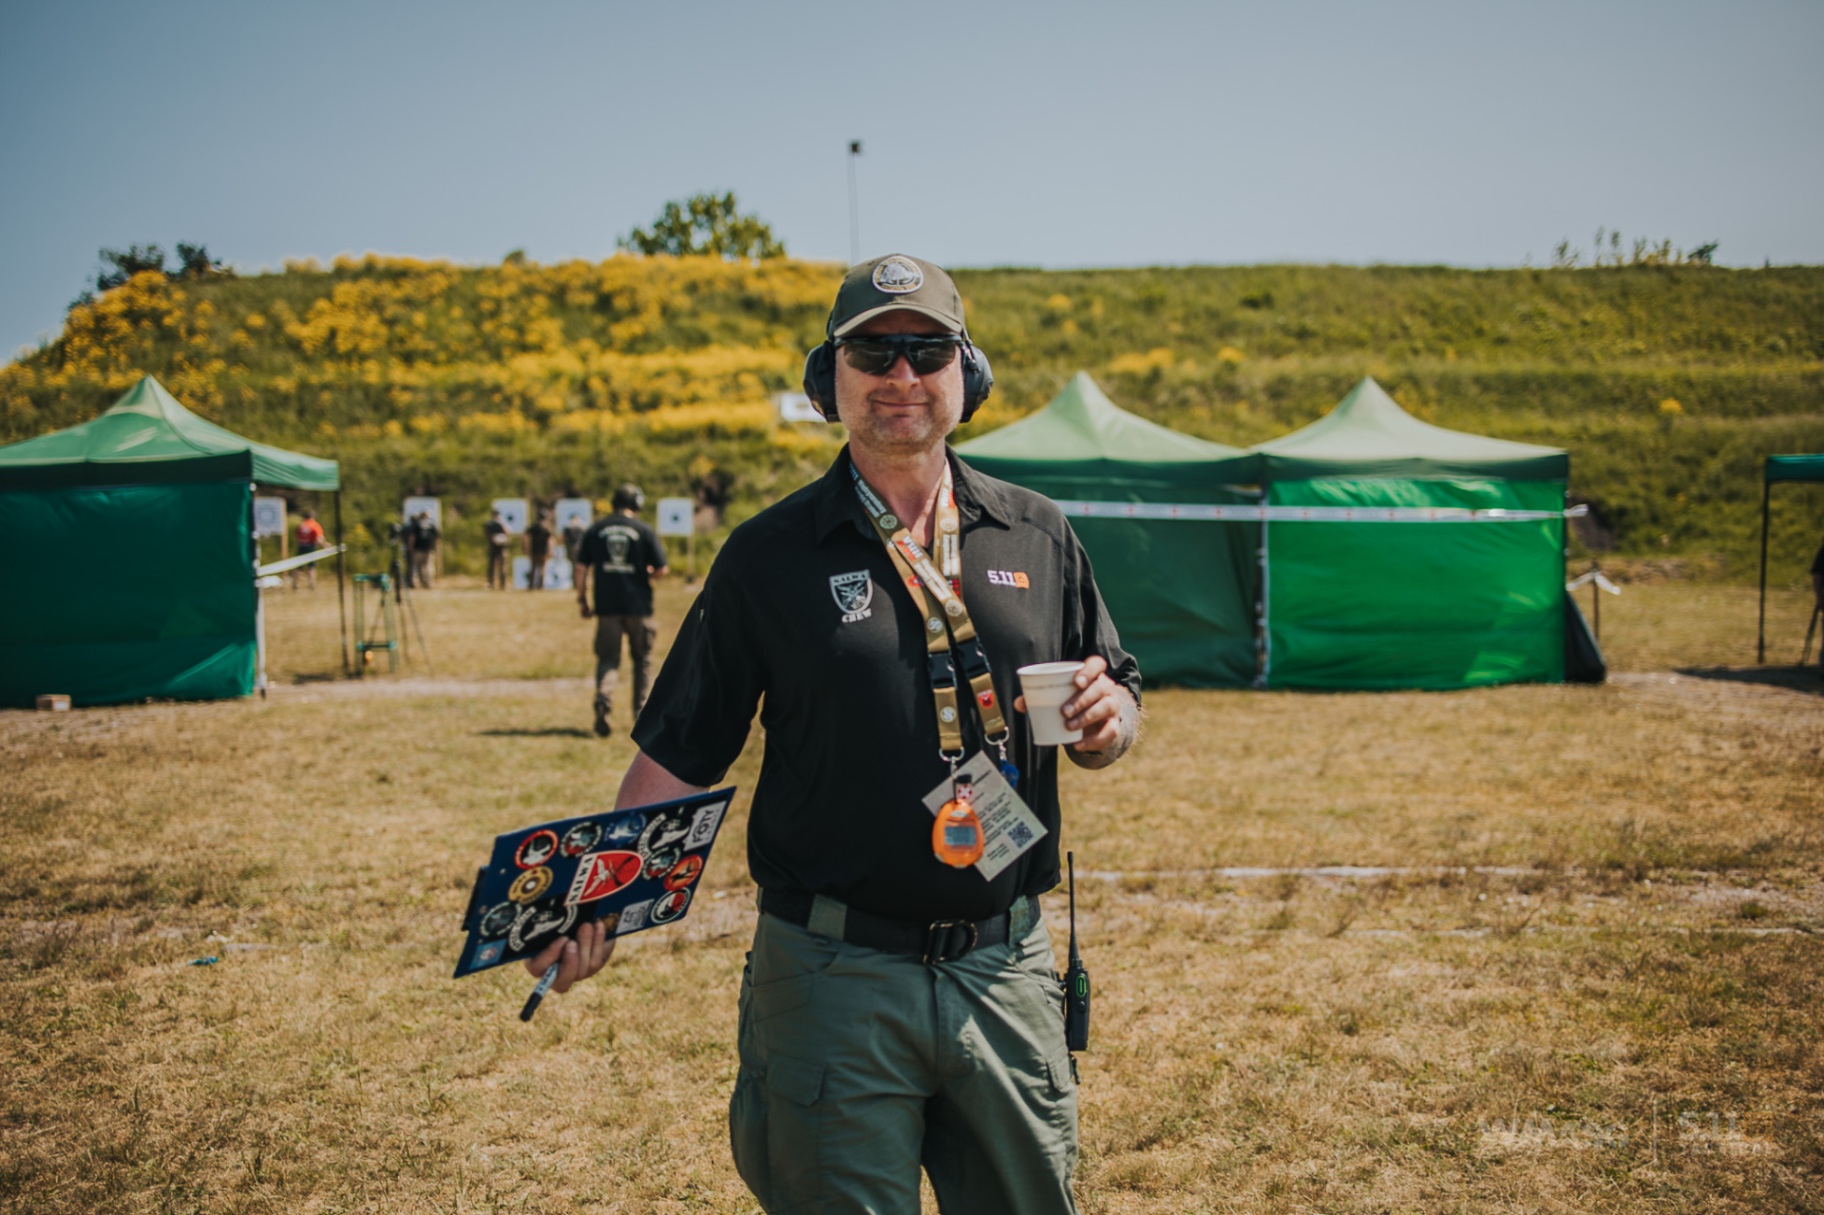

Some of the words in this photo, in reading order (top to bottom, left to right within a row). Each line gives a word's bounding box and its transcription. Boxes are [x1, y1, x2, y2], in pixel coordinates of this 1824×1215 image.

[987, 569, 1017, 587] 5.11
[842, 607, 872, 623] CREW
[568, 856, 594, 903] NALWA
